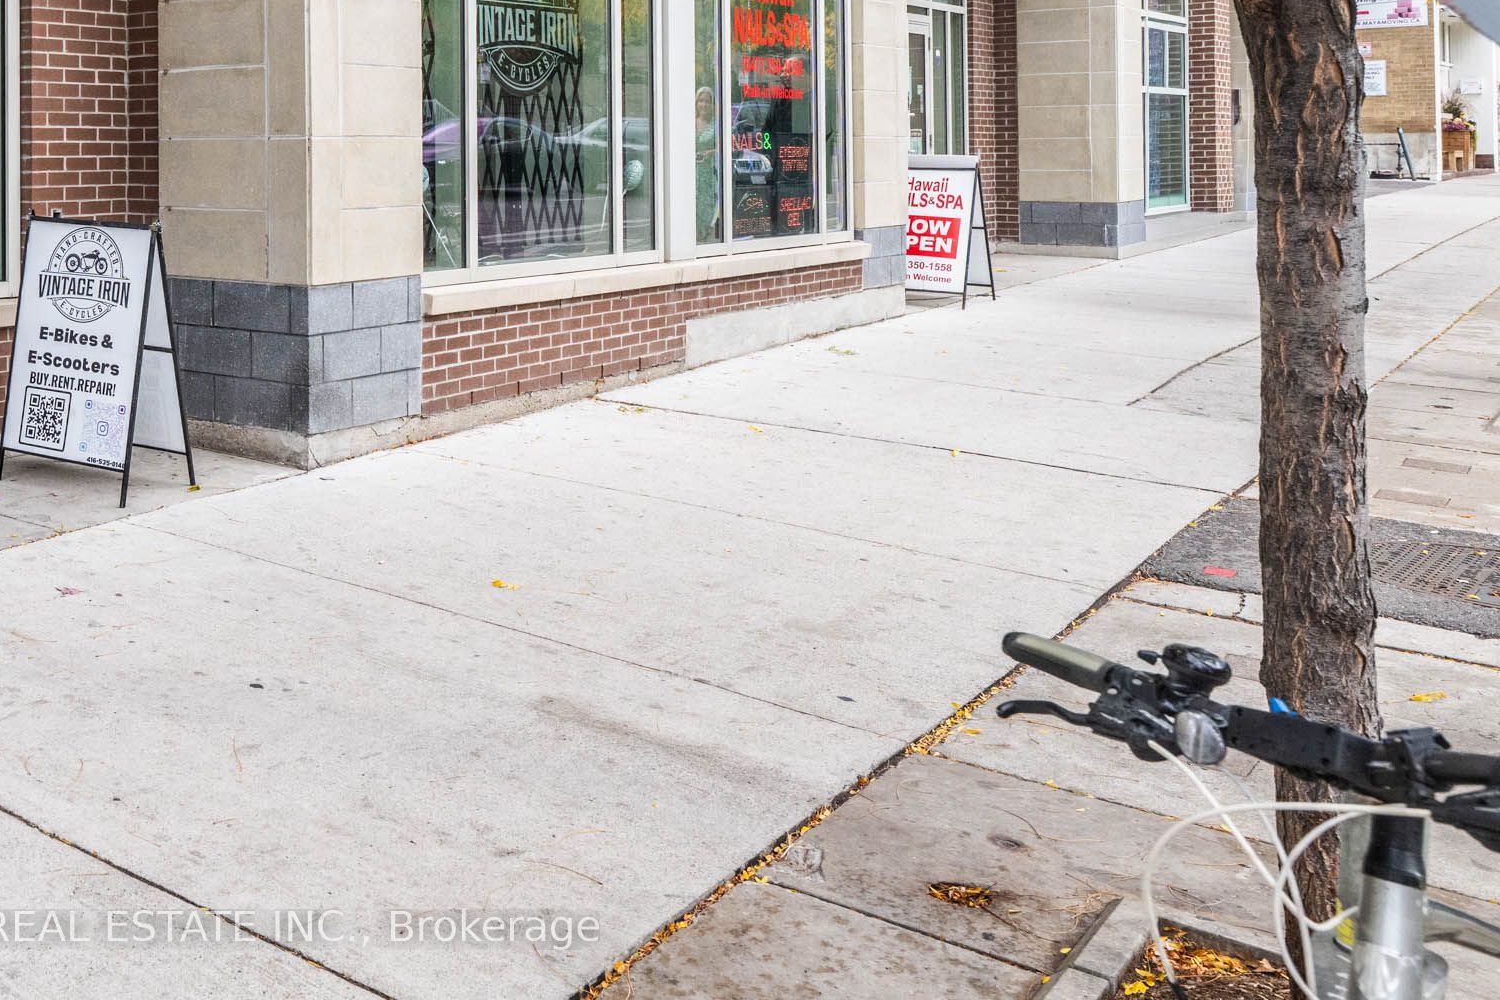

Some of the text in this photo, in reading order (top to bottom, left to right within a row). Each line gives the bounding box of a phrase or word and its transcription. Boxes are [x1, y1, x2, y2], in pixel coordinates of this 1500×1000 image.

[477, 4, 536, 47] INTAGE
[499, 52, 550, 83] E-CYCLES
[908, 193, 964, 211] ILS&SPA
[55, 231, 119, 265] HAND-CRAFTED
[906, 235, 953, 254] PEN
[908, 260, 953, 272] 350-1558
[913, 273, 952, 283] Welcome
[39, 273, 131, 309] VINTAGE IRON
[60, 301, 104, 319] E-CYCLES
[39, 326, 114, 349] E-Bikes &
[27, 350, 120, 376] E-Scooters
[29, 371, 116, 397] BUY.RENT.REPAIR!
